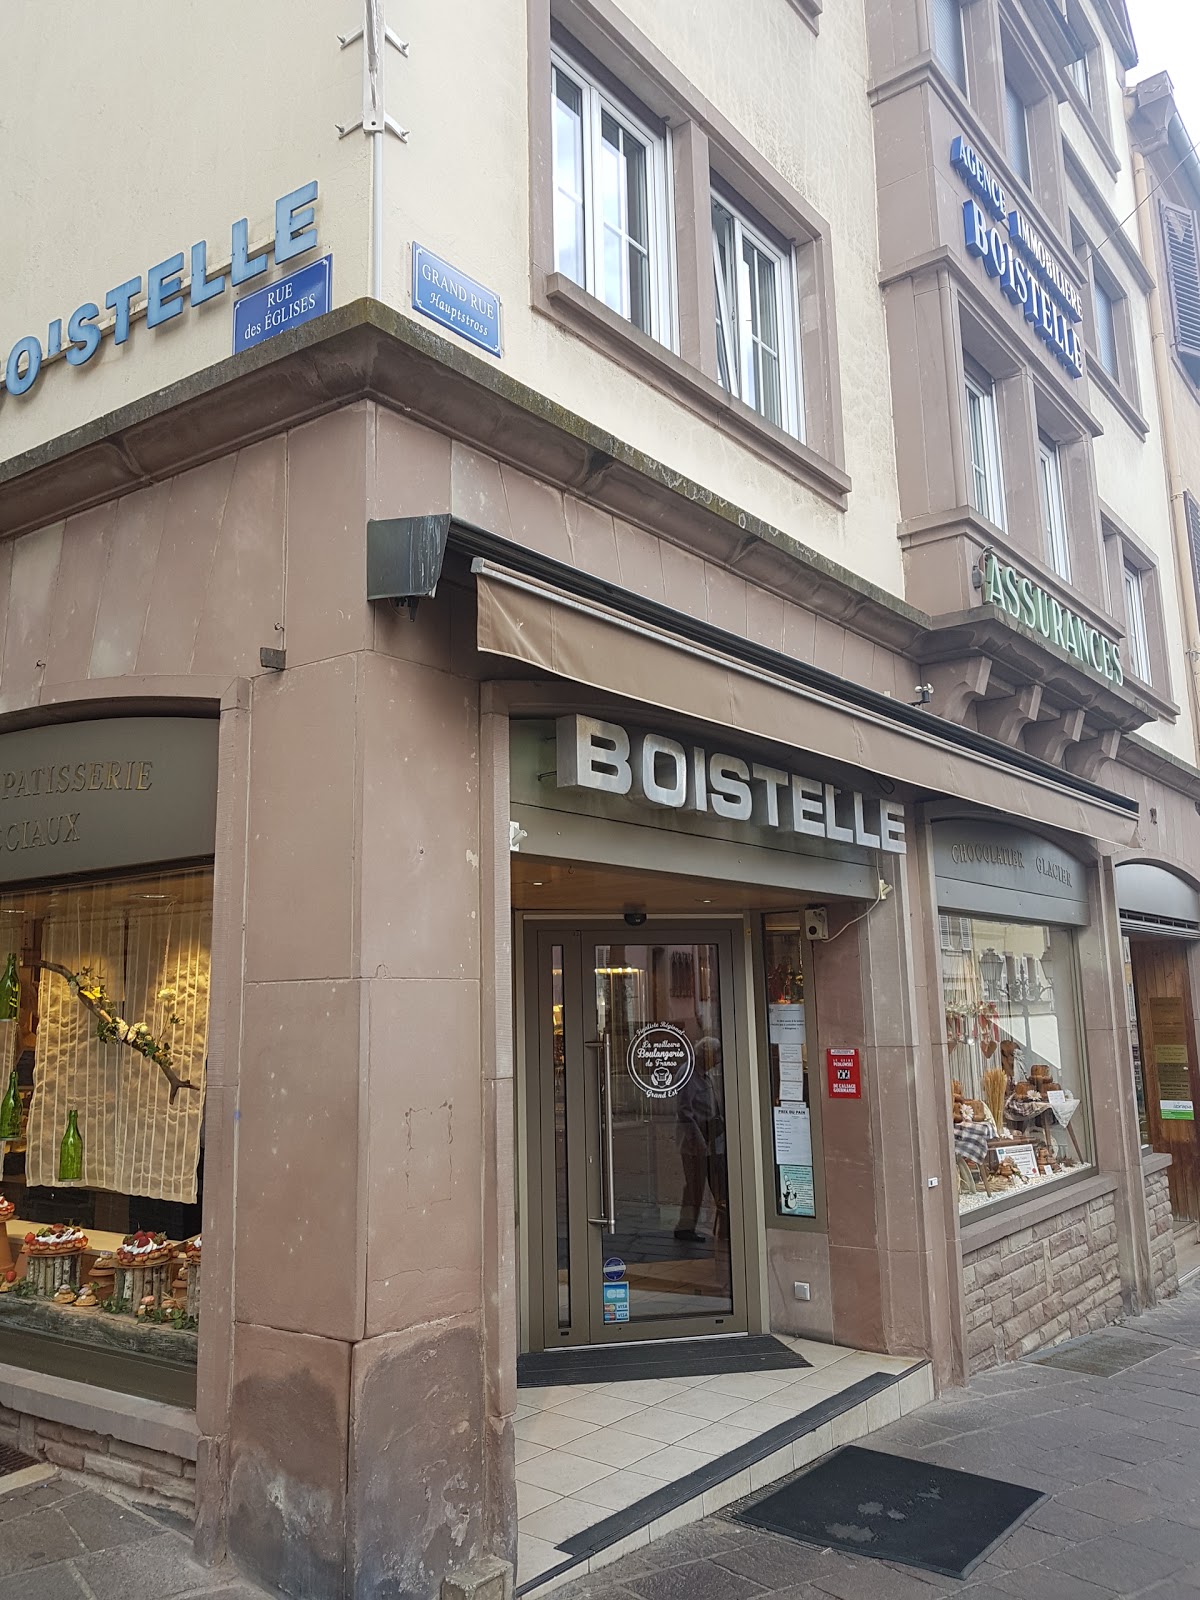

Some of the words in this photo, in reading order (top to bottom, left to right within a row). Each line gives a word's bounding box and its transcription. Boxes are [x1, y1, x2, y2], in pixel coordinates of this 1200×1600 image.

[956, 138, 1007, 219] AGENCE
[0, 180, 318, 395] OISTELLE
[267, 282, 293, 308] RUE
[422, 264, 467, 302] GRAND
[470, 292, 494, 320] RUE
[968, 199, 1083, 377] BOISTELLE
[244, 323, 262, 340] des
[264, 293, 316, 331] ÉGLISES
[429, 292, 488, 336] Hauptstross
[984, 553, 1124, 687] ASSURANCES
[1, 760, 153, 800] PATISSERIE
[570, 713, 907, 854] BOISTELLE
[0, 812, 81, 851] CIAUX
[951, 843, 1025, 869] CHOCOLATIER
[1035, 856, 1073, 888] GLACIER
[637, 1047, 685, 1061] Boulangerie
[645, 1058, 653, 1067] de
[655, 1058, 677, 1067] France
[653, 1039, 681, 1048] meilleure
[646, 1089, 667, 1099] Grand
[668, 1088, 678, 1098] Est
